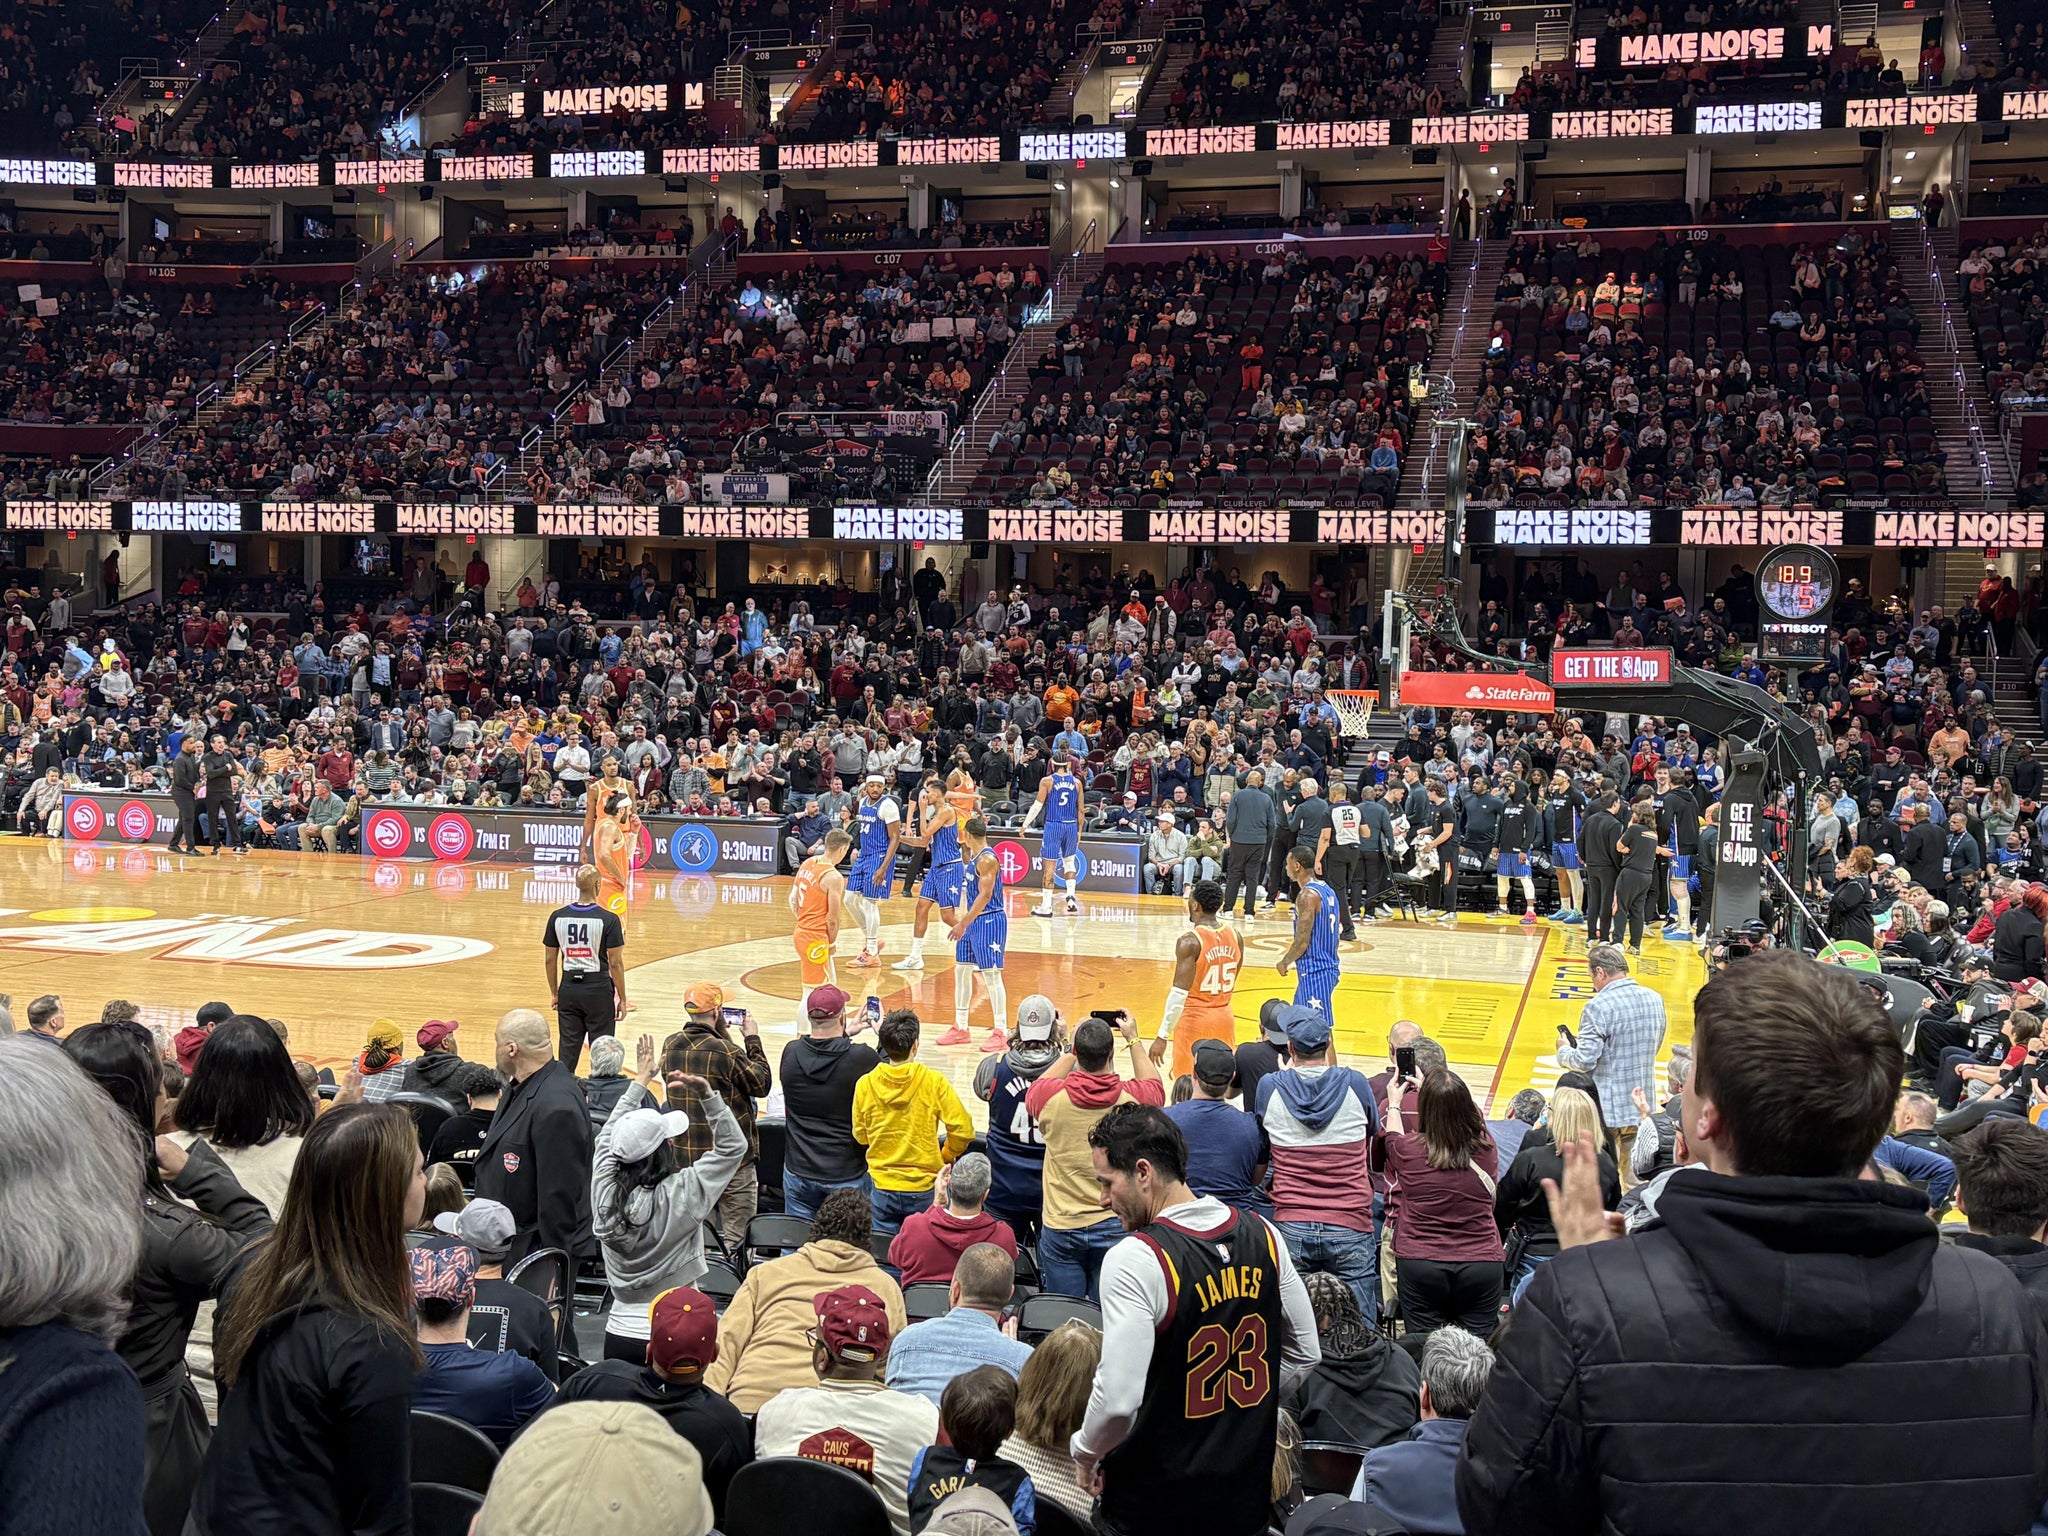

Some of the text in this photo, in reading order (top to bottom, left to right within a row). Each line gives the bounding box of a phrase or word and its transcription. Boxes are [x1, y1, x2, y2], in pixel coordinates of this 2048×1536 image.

[1483, 9, 1562, 21] 210 211
[1110, 44, 1153, 55] 209 210
[1621, 28, 1784, 61] MAKE NOISE
[755, 52, 770, 61] 208
[474, 66, 488, 75] 207
[149, 80, 165, 88] 206
[543, 84, 668, 113] MAKE NOISE
[2002, 94, 2048, 115] MAK
[1552, 114, 1672, 136] MAKE NOISE
[1757, 115, 1822, 131] NOISE
[1846, 104, 1977, 128] MAKE NOISE
[1276, 123, 1390, 146] MAKE NOISE
[1412, 123, 1528, 145] MAKE NOISE
[778, 144, 879, 165] MAKE NOISE
[898, 142, 1000, 164] MAKE NOISE
[1072, 145, 1126, 159] NOISE
[1146, 135, 1256, 156] MAKE NOISE
[441, 160, 534, 179] MAKE NOISE
[597, 162, 646, 176] NOISE
[662, 154, 760, 174] MAKE NOISE
[45, 172, 96, 185] NOISE
[114, 170, 213, 188] MAKE NOISE
[230, 166, 319, 184] MAKE NOISE
[335, 166, 424, 185] MAKE NOISE
[1686, 230, 1708, 240] 109
[1256, 244, 1284, 254] C 108
[875, 254, 902, 264] C 107
[149, 268, 176, 276] M 105
[890, 414, 913, 425] LOS
[733, 483, 758, 493] WTAM
[844, 498, 876, 506] Huntington
[1168, 500, 1203, 508] Huntington
[1288, 499, 1325, 508] Huntington
[1588, 498, 1628, 508] Huntington
[6, 506, 112, 527] MAKE NOISE
[185, 515, 242, 532] NOISE
[262, 512, 375, 532] MAKE NOISE
[397, 507, 514, 528] MAKE NOISE
[537, 515, 660, 536] MAKE NOISE
[683, 514, 809, 536] MAKE NOISE
[1149, 512, 1290, 537] MAKE NOISE
[898, 522, 964, 540] NOISE
[988, 520, 1123, 542] MAKE NOISE
[1318, 518, 1388, 540] MAKE
[1571, 526, 1650, 544] NOISE
[1681, 522, 1843, 546] MAKE NOISE
[1874, 514, 2046, 542] MAKE NOISE
[1986, 548, 1999, 558] EXIT
[1778, 566, 1812, 583] 18.9
[1798, 586, 1814, 610] 5
[1781, 624, 1828, 634] TISSOT
[1564, 656, 1658, 681] GET THE App
[1485, 686, 1550, 702] State Farm
[1610, 720, 1622, 728] 23
[1058, 792, 1070, 806] 5
[1342, 809, 1354, 820] 25
[1730, 804, 1754, 822] GET
[106, 813, 116, 826] VS
[156, 814, 174, 832] 7PM
[414, 826, 510, 850] VS 7PM ET
[1730, 824, 1752, 842] THE
[534, 848, 580, 862] ESPN
[655, 838, 774, 862] VS 9:30PM ET
[1734, 843, 1757, 866] App
[1032, 857, 1136, 878] VS 9:30PM ET
[568, 924, 588, 945] 94
[1204, 946, 1237, 963] MITCHELL
[1200, 962, 1238, 996] 45
[1195, 1266, 1262, 1312] JAMES
[1185, 1312, 1270, 1419] 23
[823, 1440, 850, 1456] CAVS
